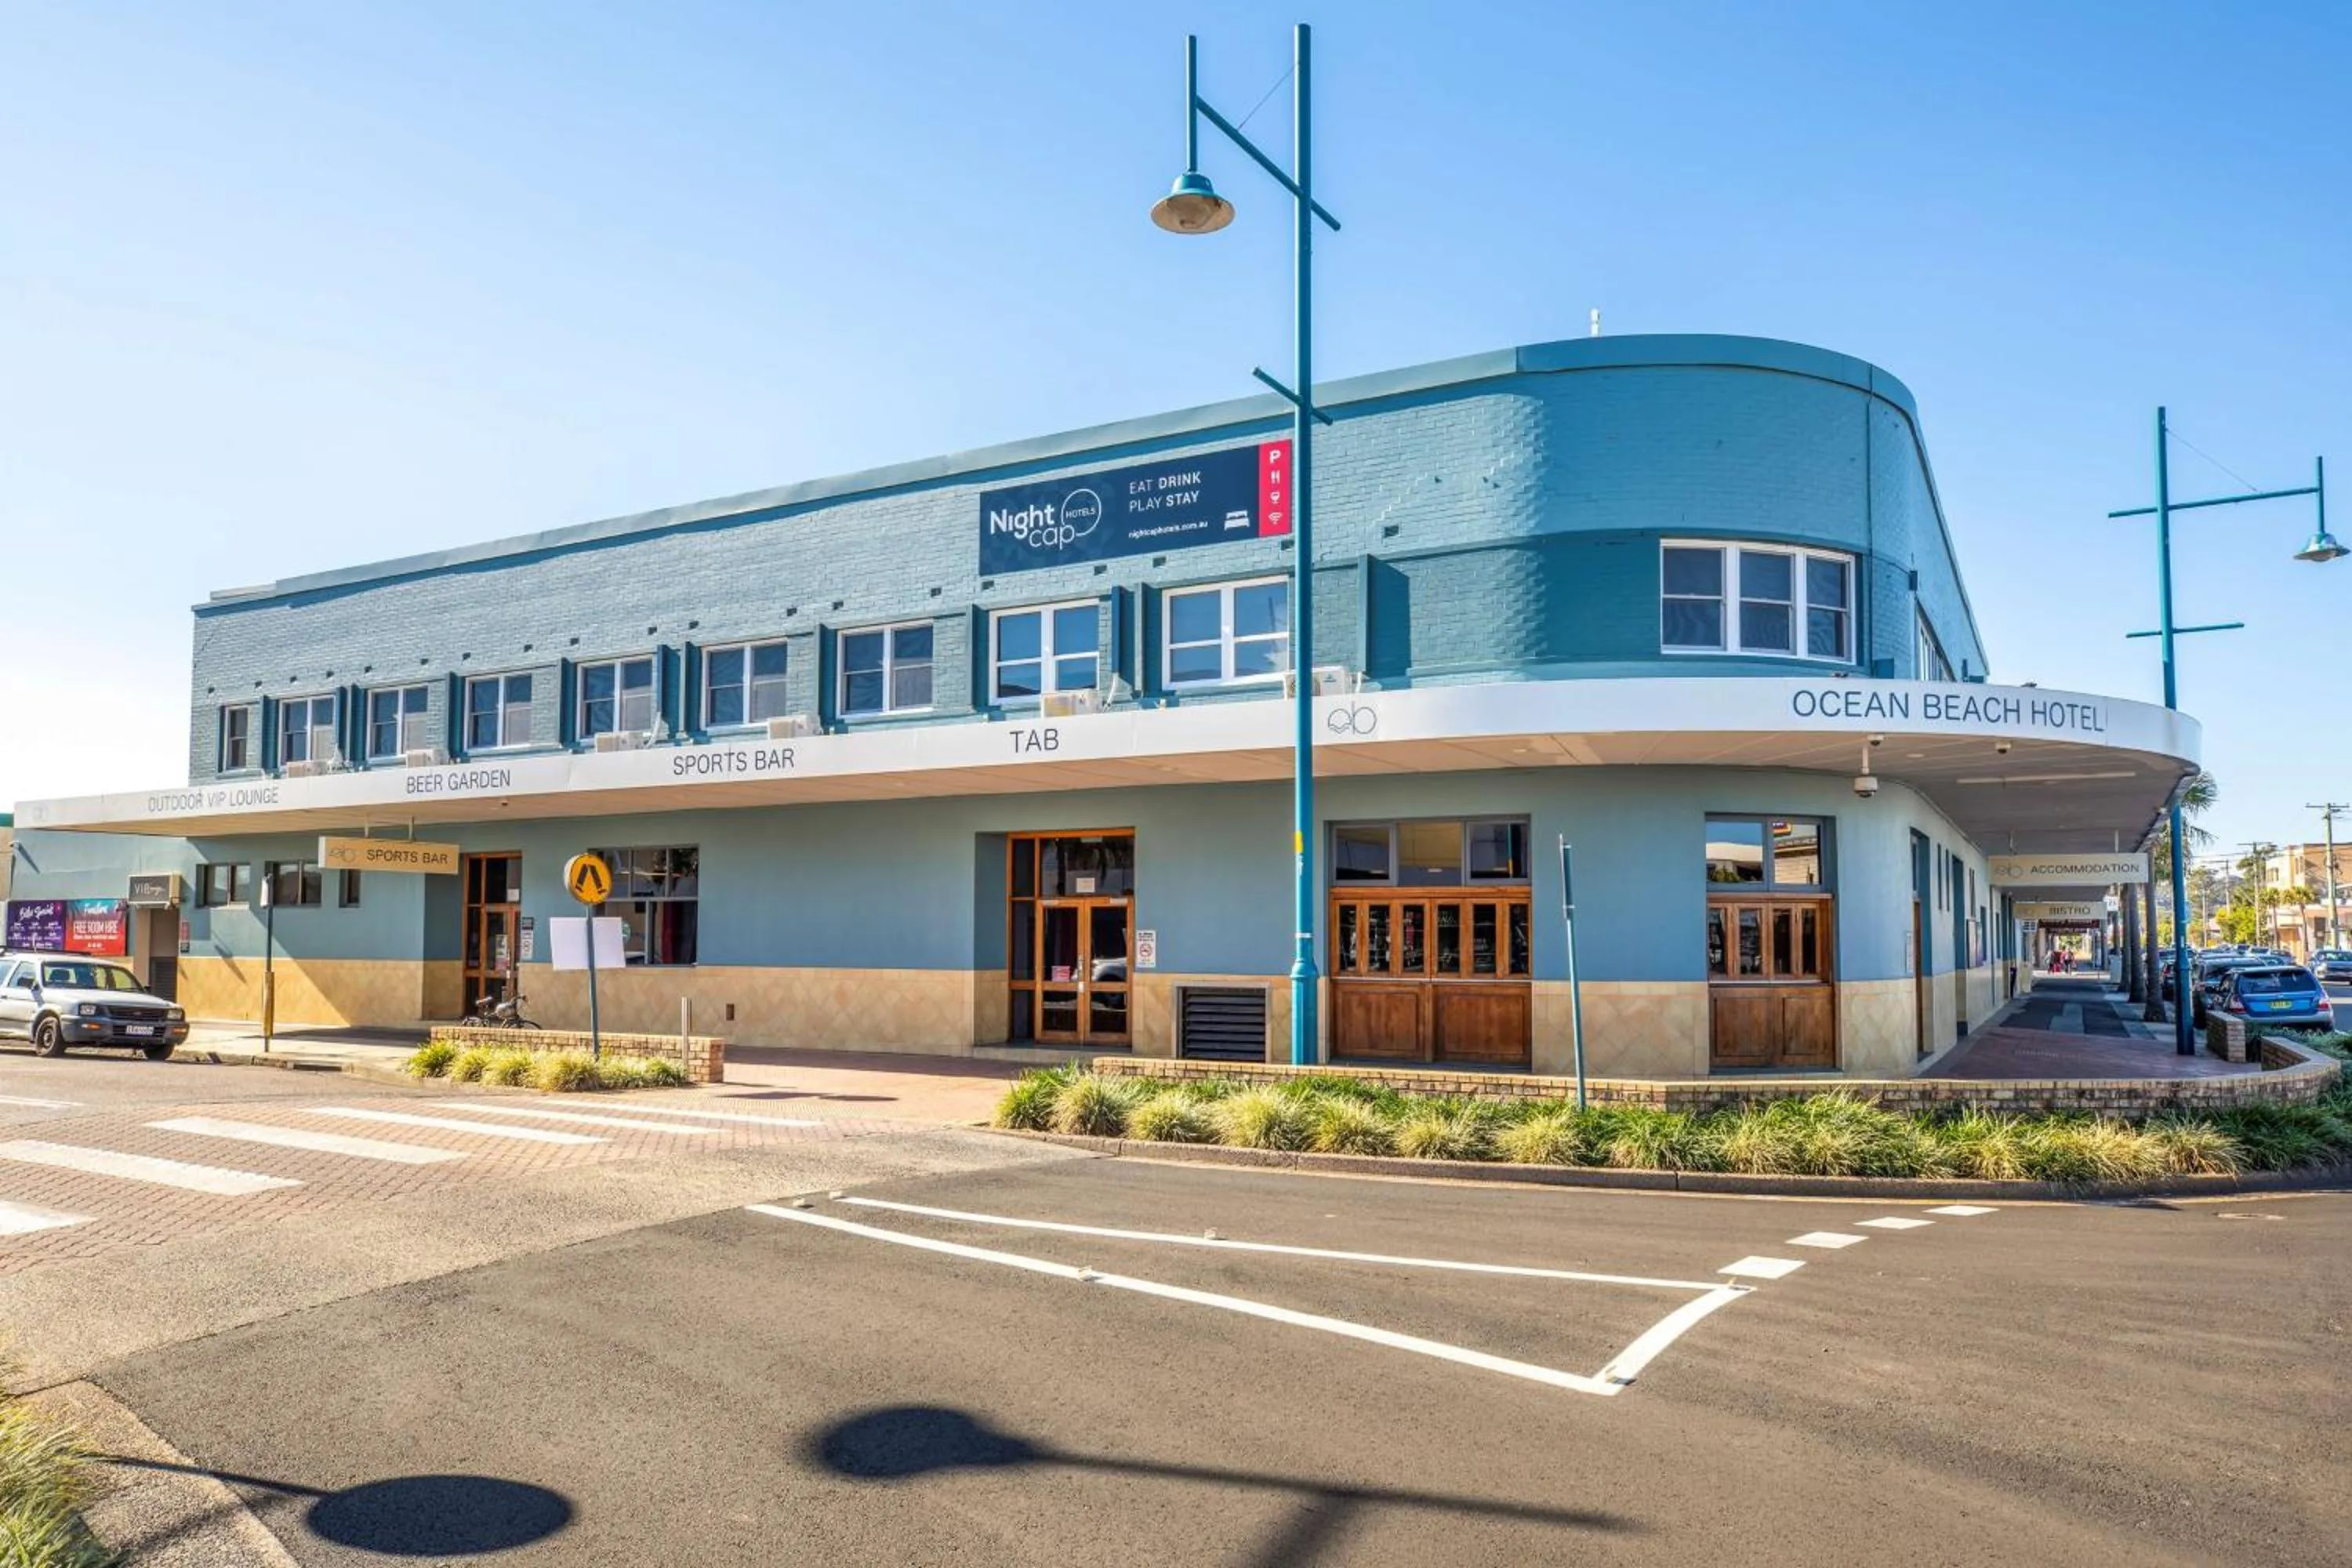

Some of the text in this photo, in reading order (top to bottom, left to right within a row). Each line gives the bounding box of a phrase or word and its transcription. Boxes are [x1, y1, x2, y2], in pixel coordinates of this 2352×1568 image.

[1269, 449, 1281, 463] P
[1129, 472, 1202, 494] EAT DRINK
[1065, 507, 1096, 519] HOTELS
[1129, 491, 1200, 512] PLAY STAY
[990, 503, 1054, 539] Night
[1029, 524, 1075, 550] cap
[1792, 690, 2104, 732] OCEAN BEACH HOTEL
[1010, 728, 1060, 753] TAB
[673, 748, 794, 775] SPORTS BAR
[406, 769, 510, 794] BEER GARDEN
[147, 787, 279, 812] OUTDOOR VIP LOUNGE
[367, 849, 418, 863] SPORTS
[423, 851, 448, 864] BAR
[2031, 863, 2140, 874] ACCOMMODATION
[2049, 906, 2091, 916] BISTRO
